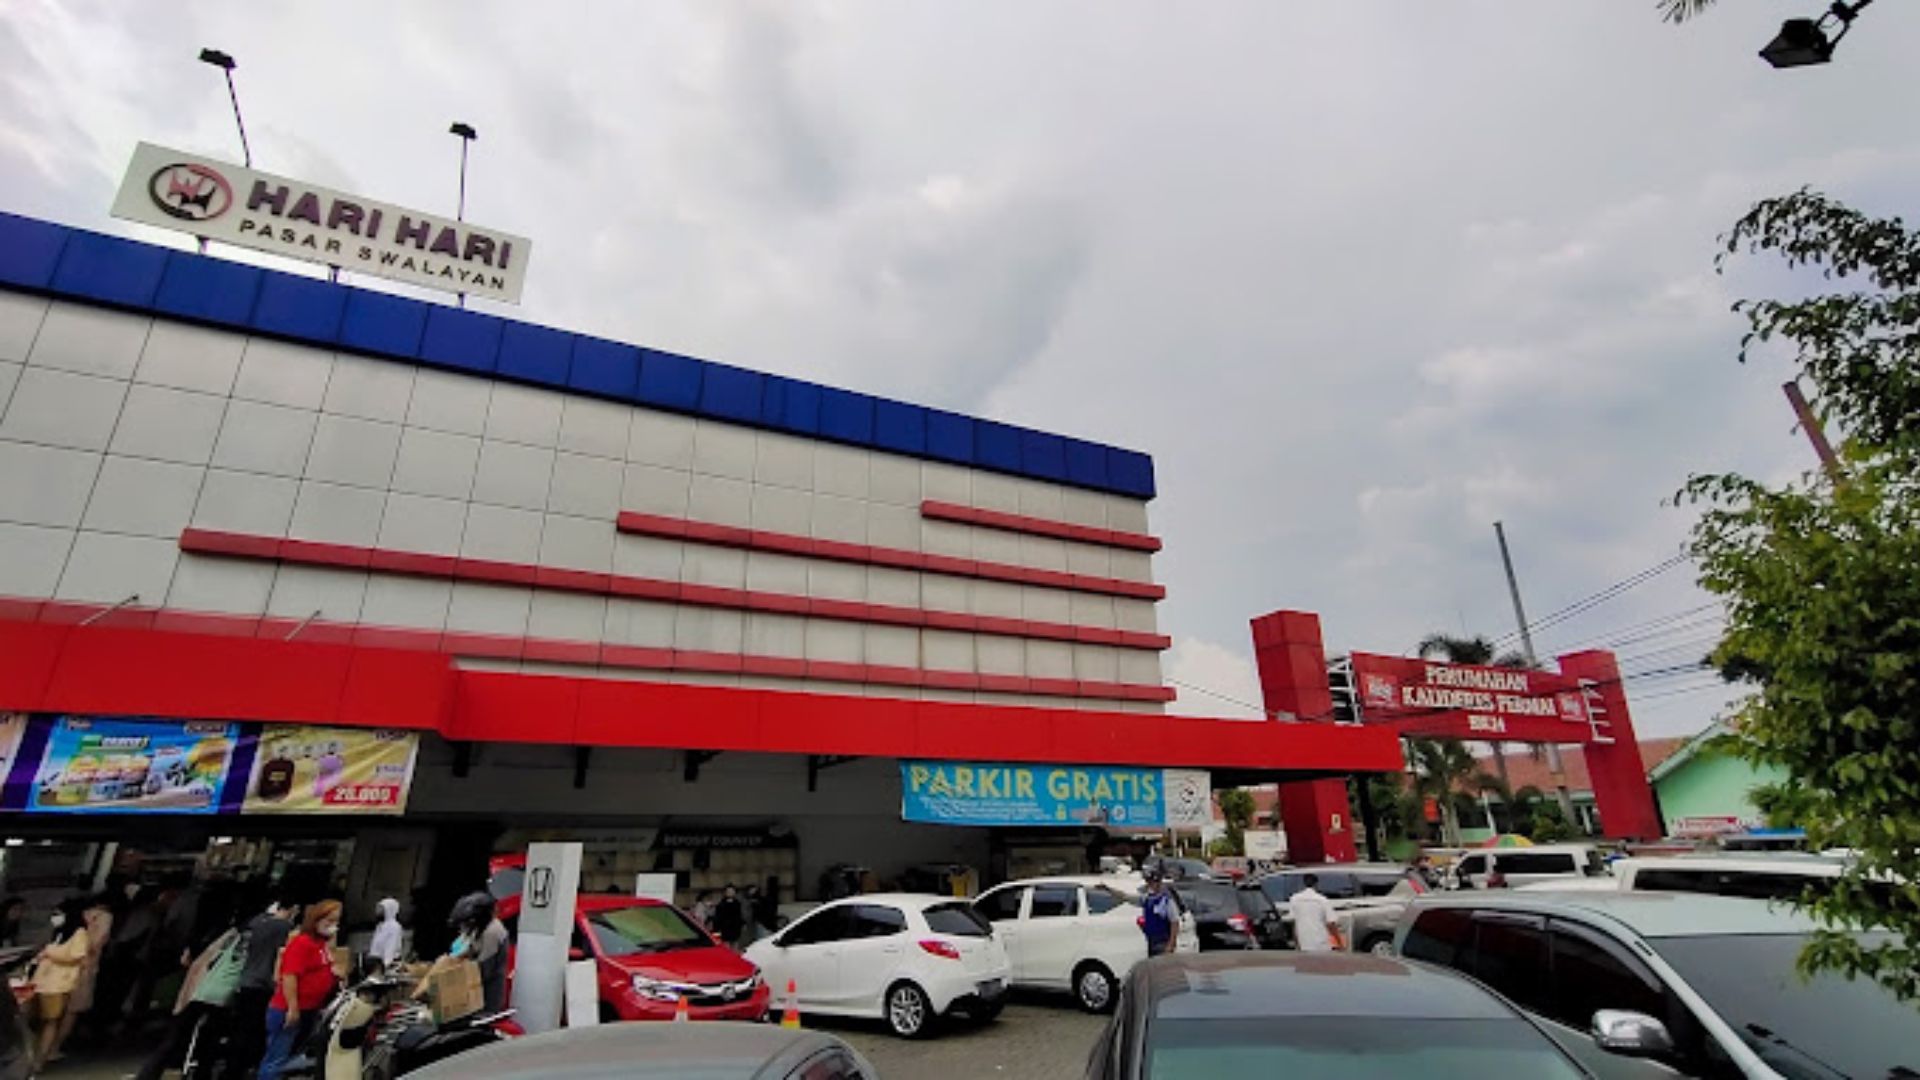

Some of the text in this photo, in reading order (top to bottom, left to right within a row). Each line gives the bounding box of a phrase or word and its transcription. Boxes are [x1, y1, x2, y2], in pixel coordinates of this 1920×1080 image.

[246, 180, 512, 269] HARI HARI
[239, 218, 506, 290] PASAR SWALAYAN
[1425, 664, 1528, 692] PERUMAHAN
[910, 765, 1158, 803] PARKIR GRATIS
[663, 834, 710, 847] DEPOSIT
[712, 835, 763, 847] COUNTER
